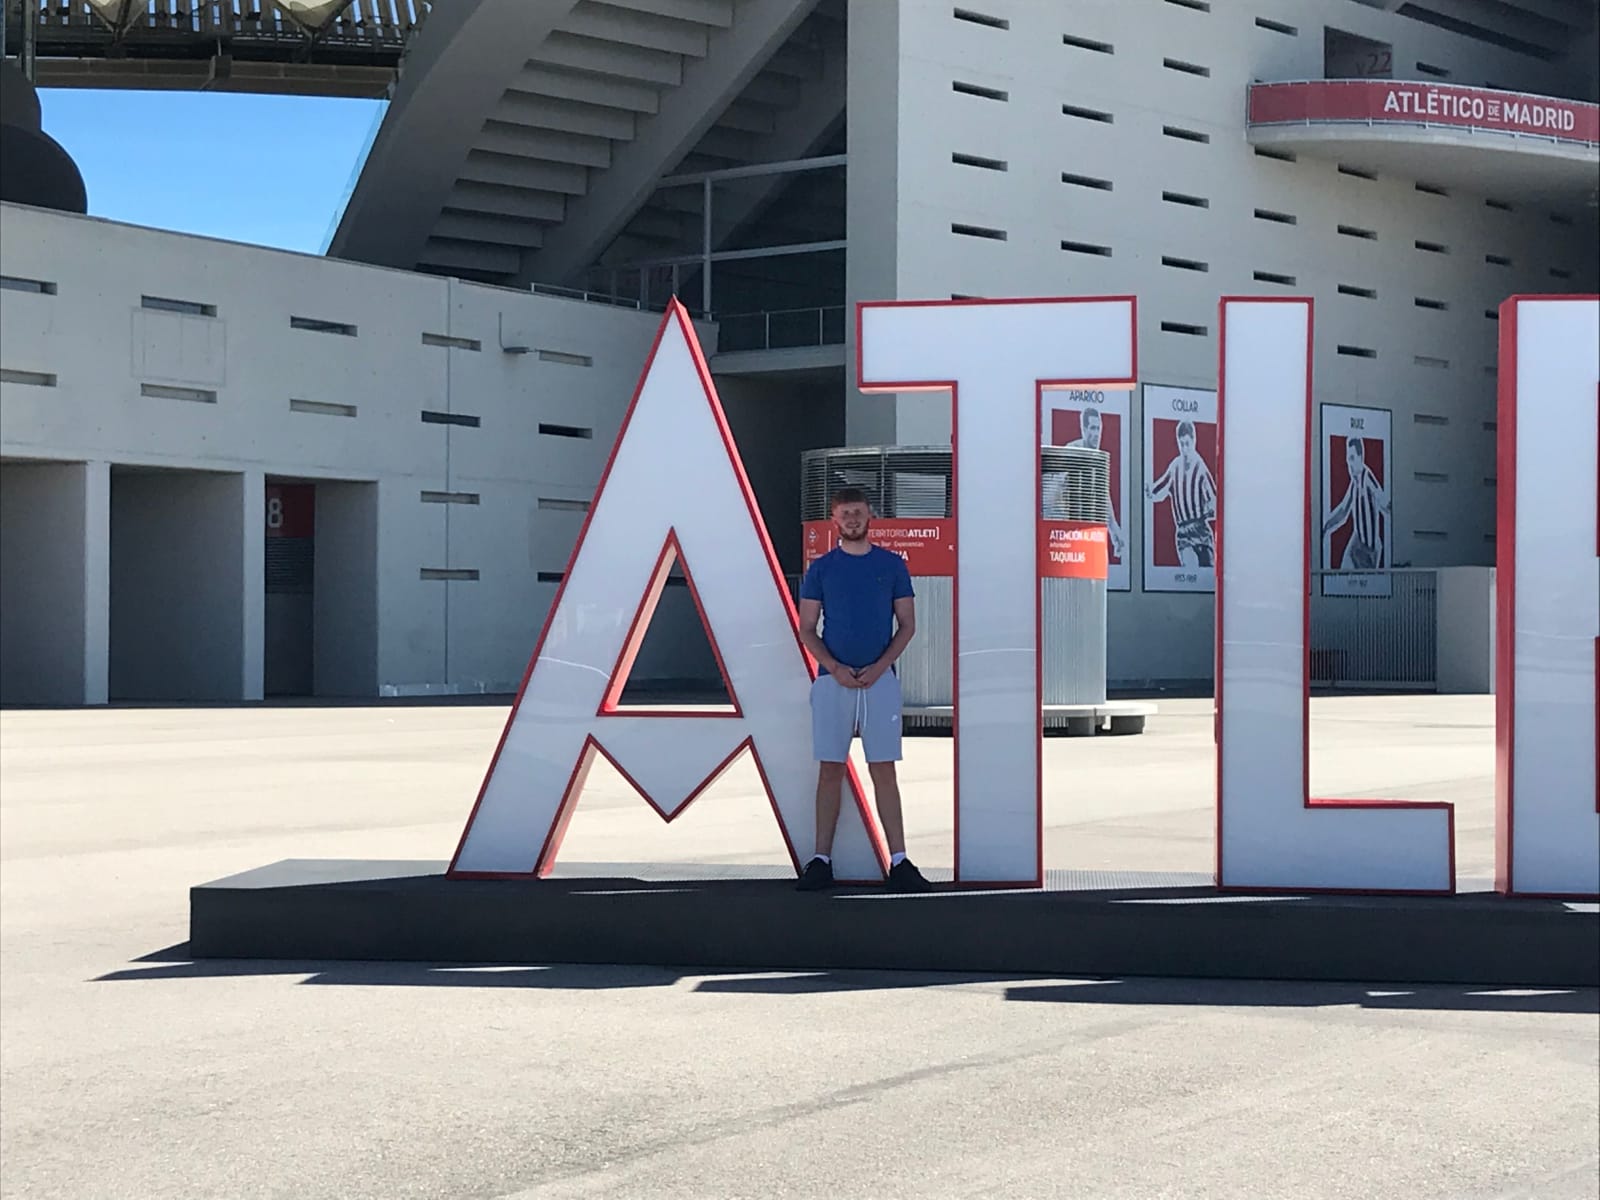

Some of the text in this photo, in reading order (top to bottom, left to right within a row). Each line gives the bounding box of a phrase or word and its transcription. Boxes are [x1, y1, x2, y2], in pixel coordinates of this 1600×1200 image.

[1383, 89, 1575, 131] ATLÉTICO DE MADRID
[1069, 390, 1105, 404] APARICIO
[1172, 399, 1199, 412] COLLAR
[1350, 417, 1365, 430] RUIZ
[1049, 551, 1086, 564] TAQUILLAS
